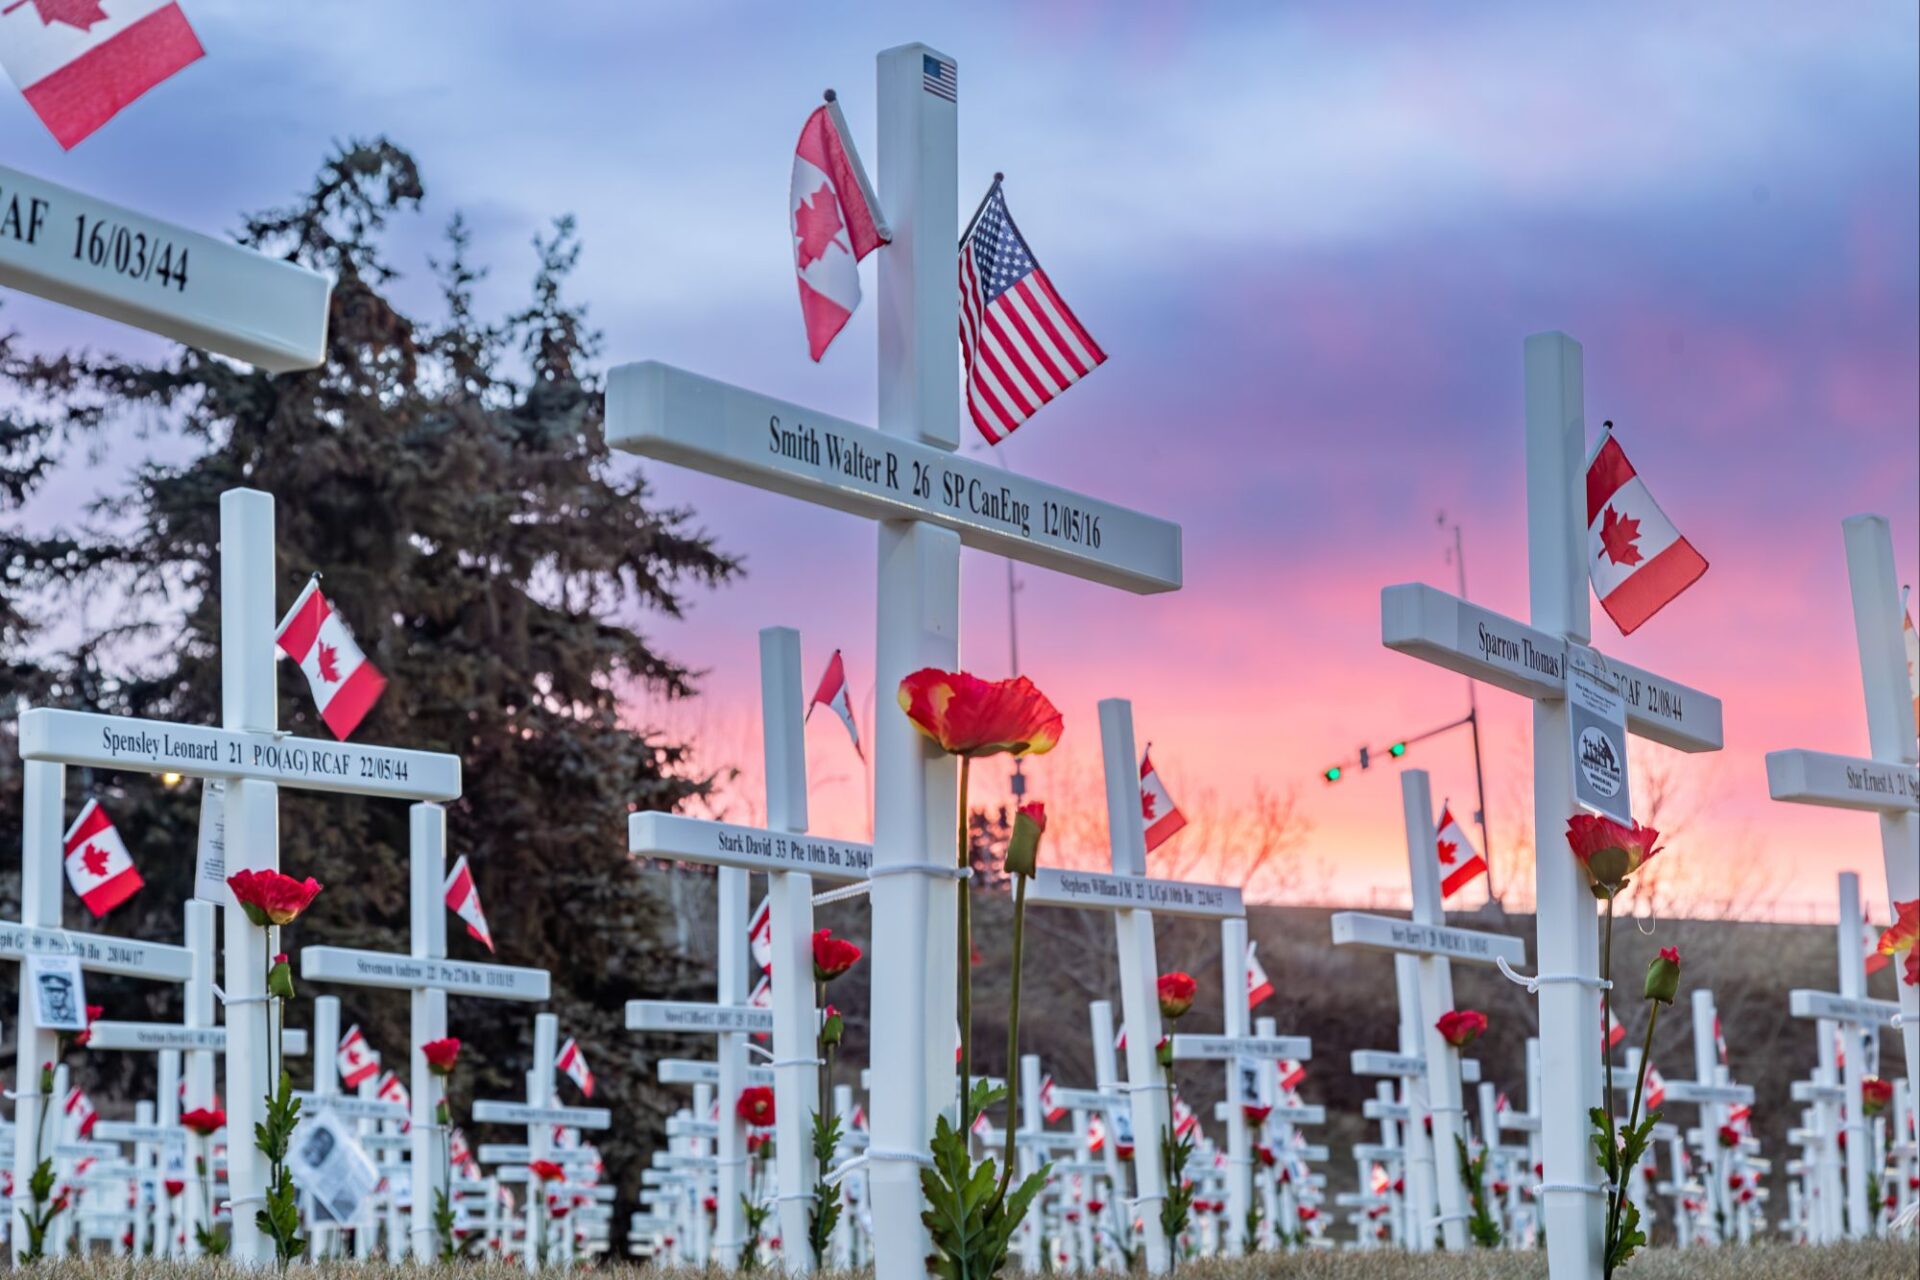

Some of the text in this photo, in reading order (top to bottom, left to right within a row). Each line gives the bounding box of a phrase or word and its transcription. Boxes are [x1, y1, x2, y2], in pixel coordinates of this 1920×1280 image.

[0, 188, 188, 292] AF 16/03/44
[769, 415, 1101, 549] Smith Walter R 26 SP CanEng 12/05/16
[1478, 622, 1519, 661] Sparrow
[1521, 638, 1559, 678] Thomas
[1647, 684, 1683, 722] 22/08/44
[103, 726, 408, 781] Spensley Leonard 21 P/O(AG) RCAF 22/05/44
[718, 831, 744, 853] Stark
[746, 835, 771, 857] David
[775, 839, 786, 859] 33
[791, 841, 805, 860] Pte
[807, 844, 826, 864] 10th
[828, 846, 841, 866] Bn
